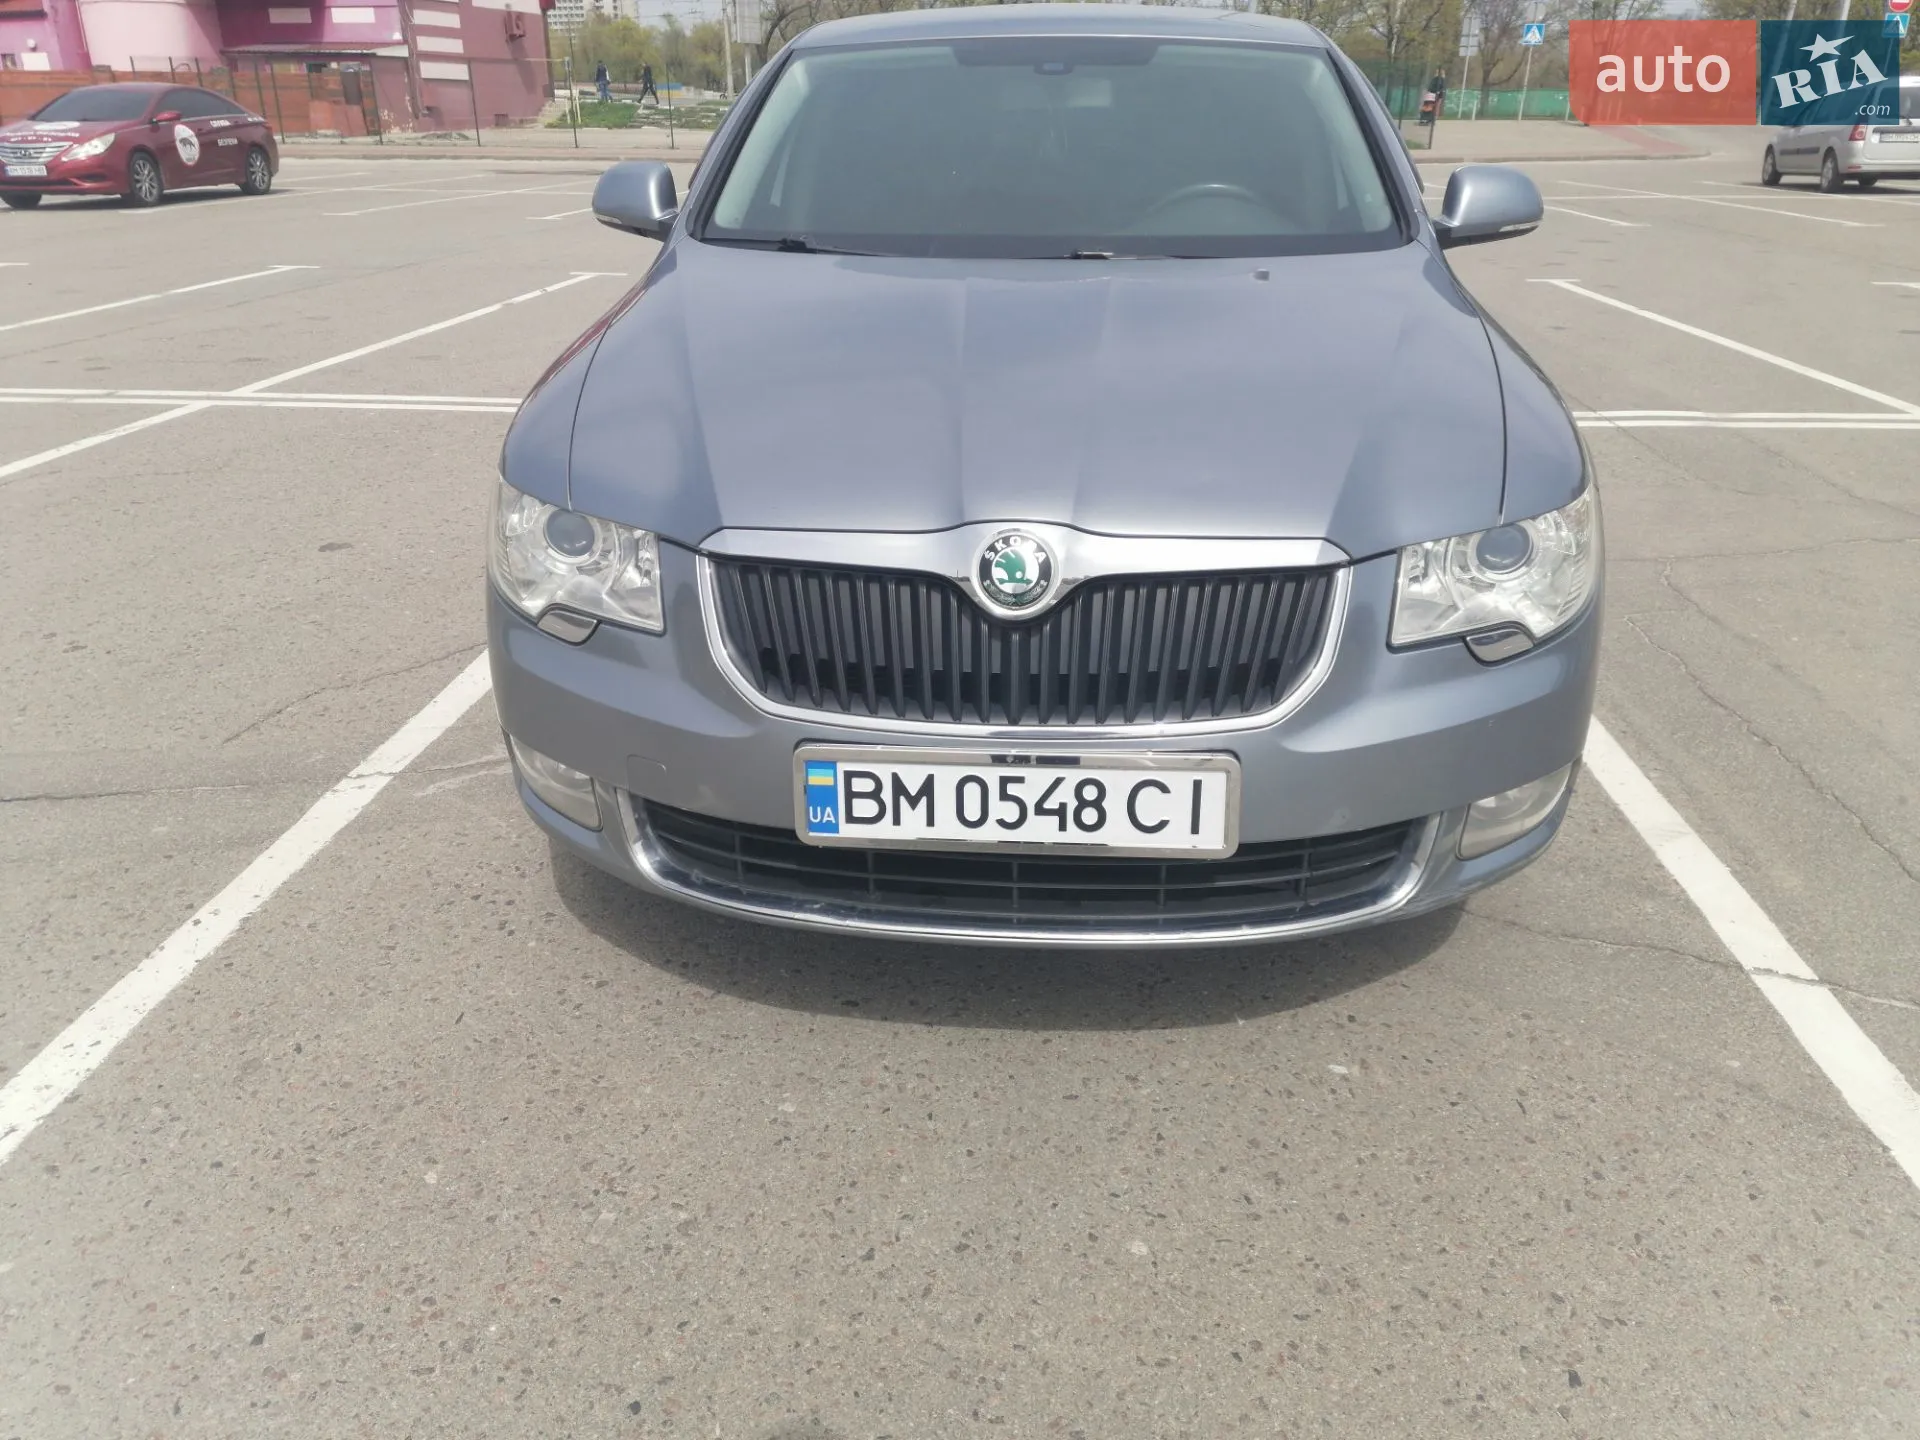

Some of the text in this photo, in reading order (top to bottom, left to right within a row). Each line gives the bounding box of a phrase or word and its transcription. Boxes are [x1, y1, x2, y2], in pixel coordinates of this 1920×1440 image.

[809, 806, 836, 824] UA
[843, 769, 1203, 835] BM 0548 CI
